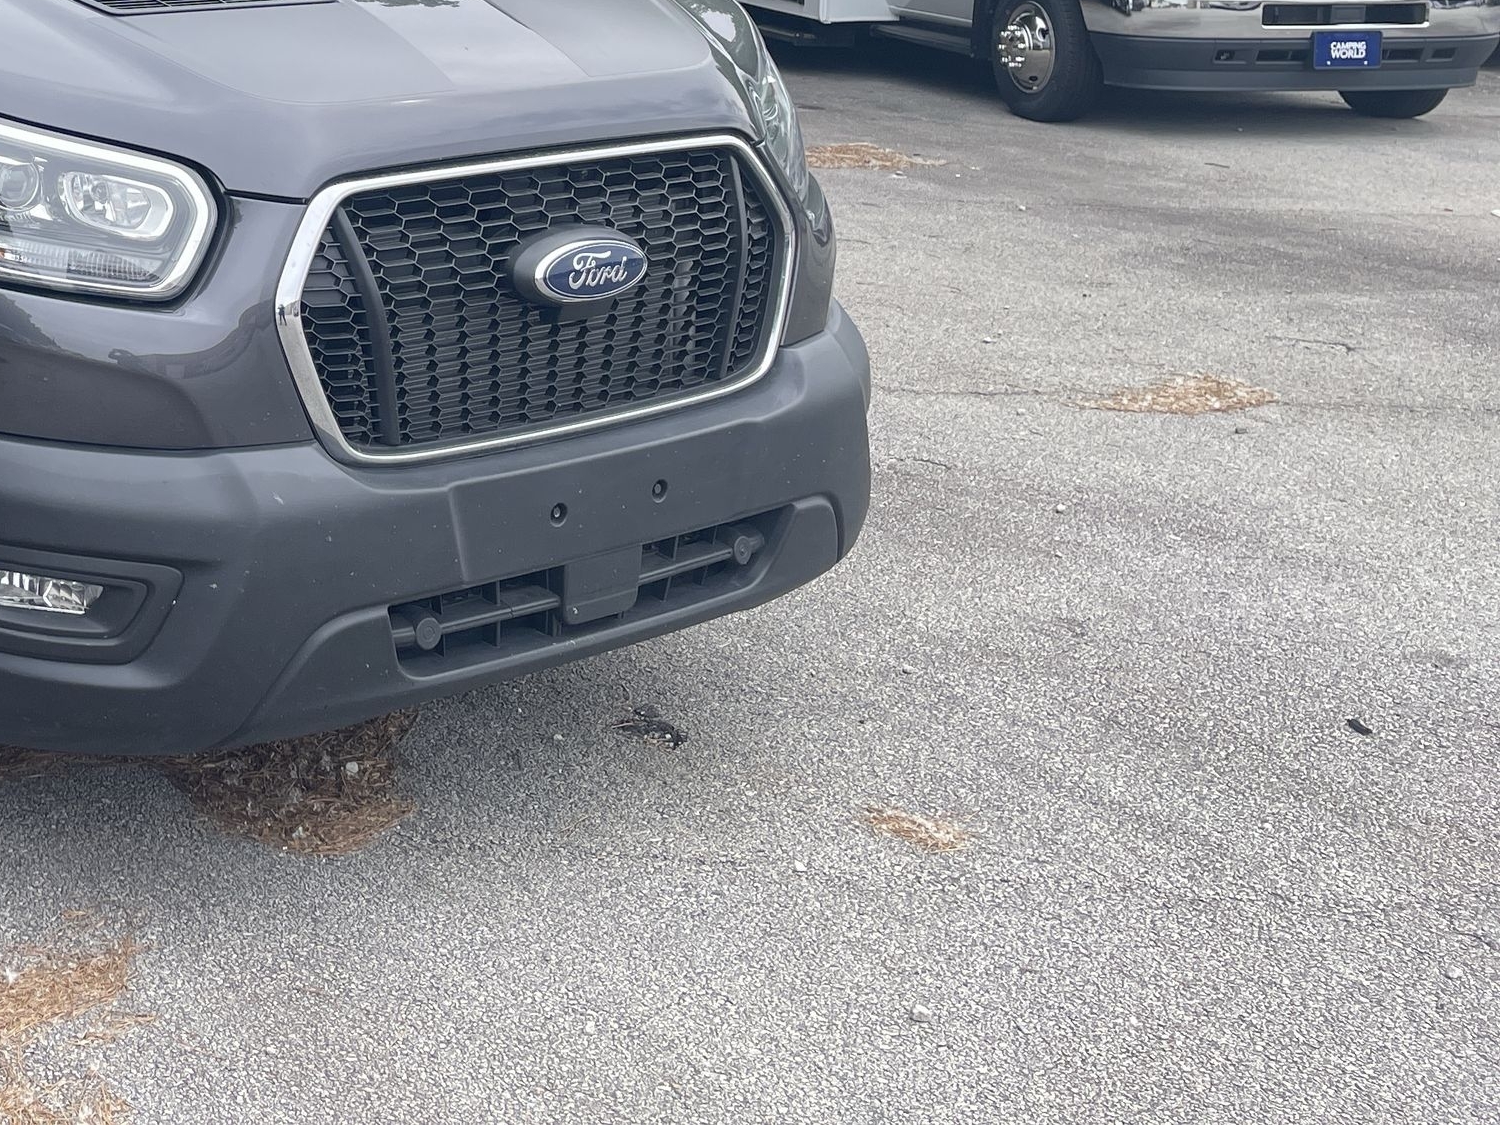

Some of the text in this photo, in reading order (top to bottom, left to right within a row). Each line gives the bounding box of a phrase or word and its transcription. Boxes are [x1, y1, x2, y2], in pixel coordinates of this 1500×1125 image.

[1330, 41, 1367, 50] CAMPING
[1330, 49, 1366, 59] WORLD
[569, 251, 629, 289] Ford
